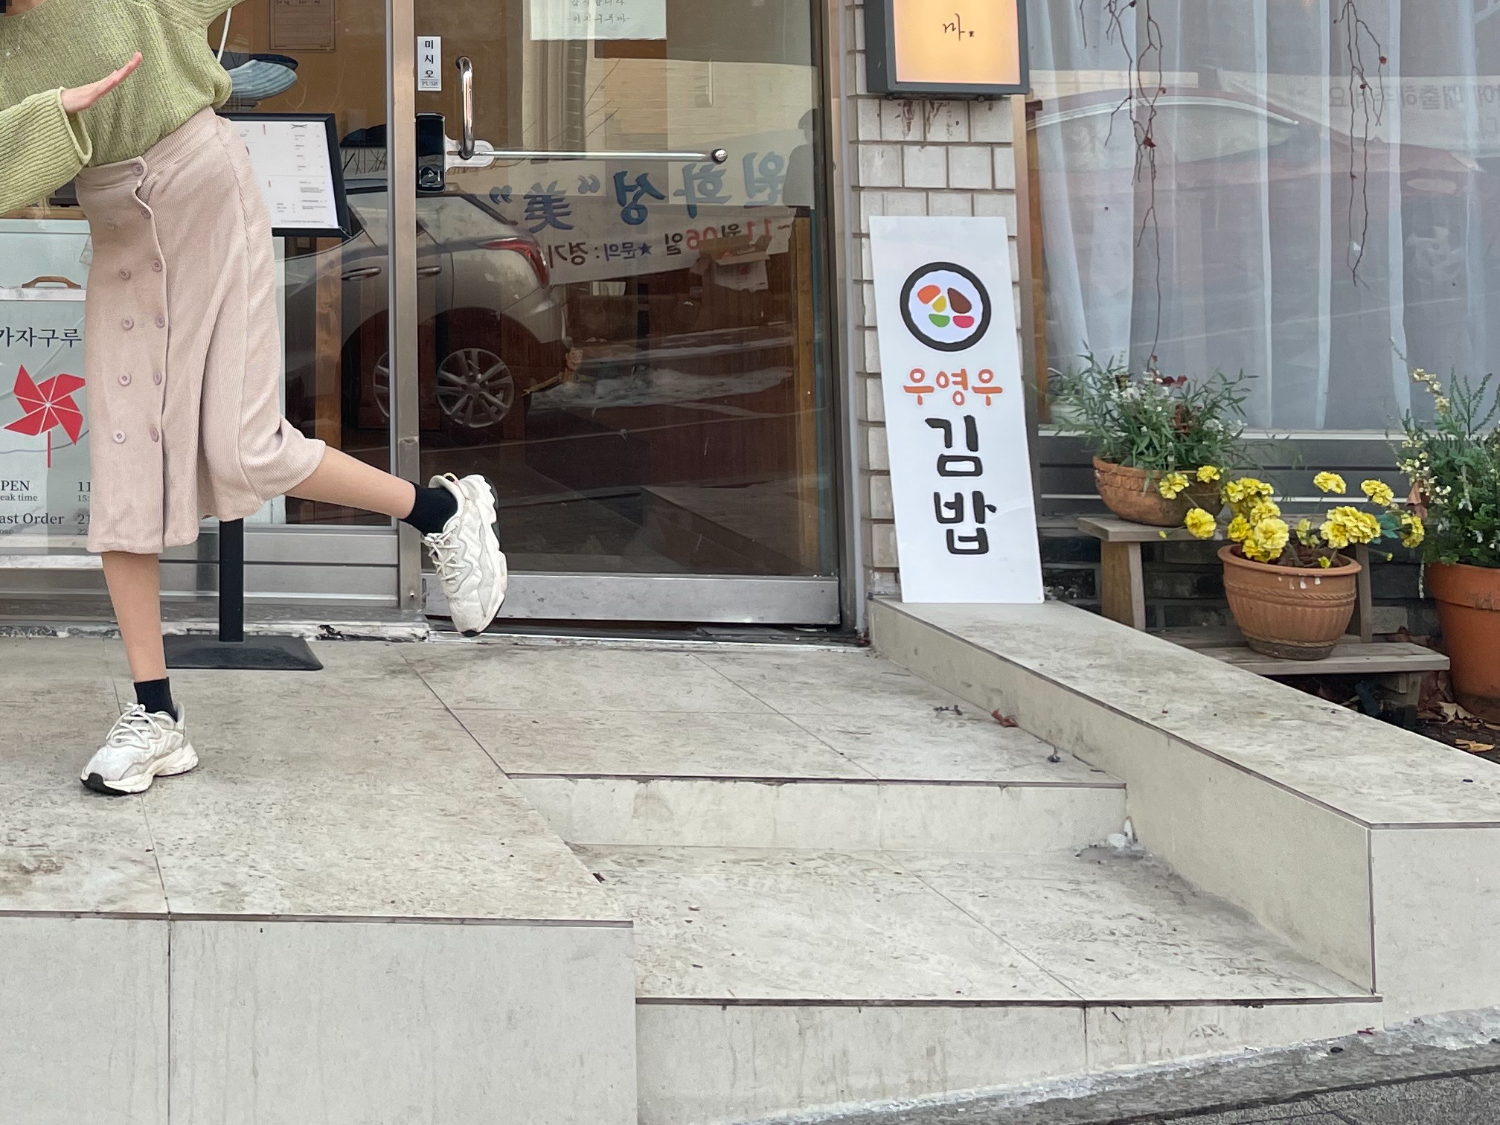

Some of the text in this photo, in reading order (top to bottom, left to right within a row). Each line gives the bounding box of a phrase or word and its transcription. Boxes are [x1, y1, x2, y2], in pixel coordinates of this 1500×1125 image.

[424, 39, 435, 78] 미시오
[903, 368, 1003, 406] 우영우
[18, 493, 38, 502] time
[925, 415, 997, 555] 김밥
[22, 512, 65, 525] Order
